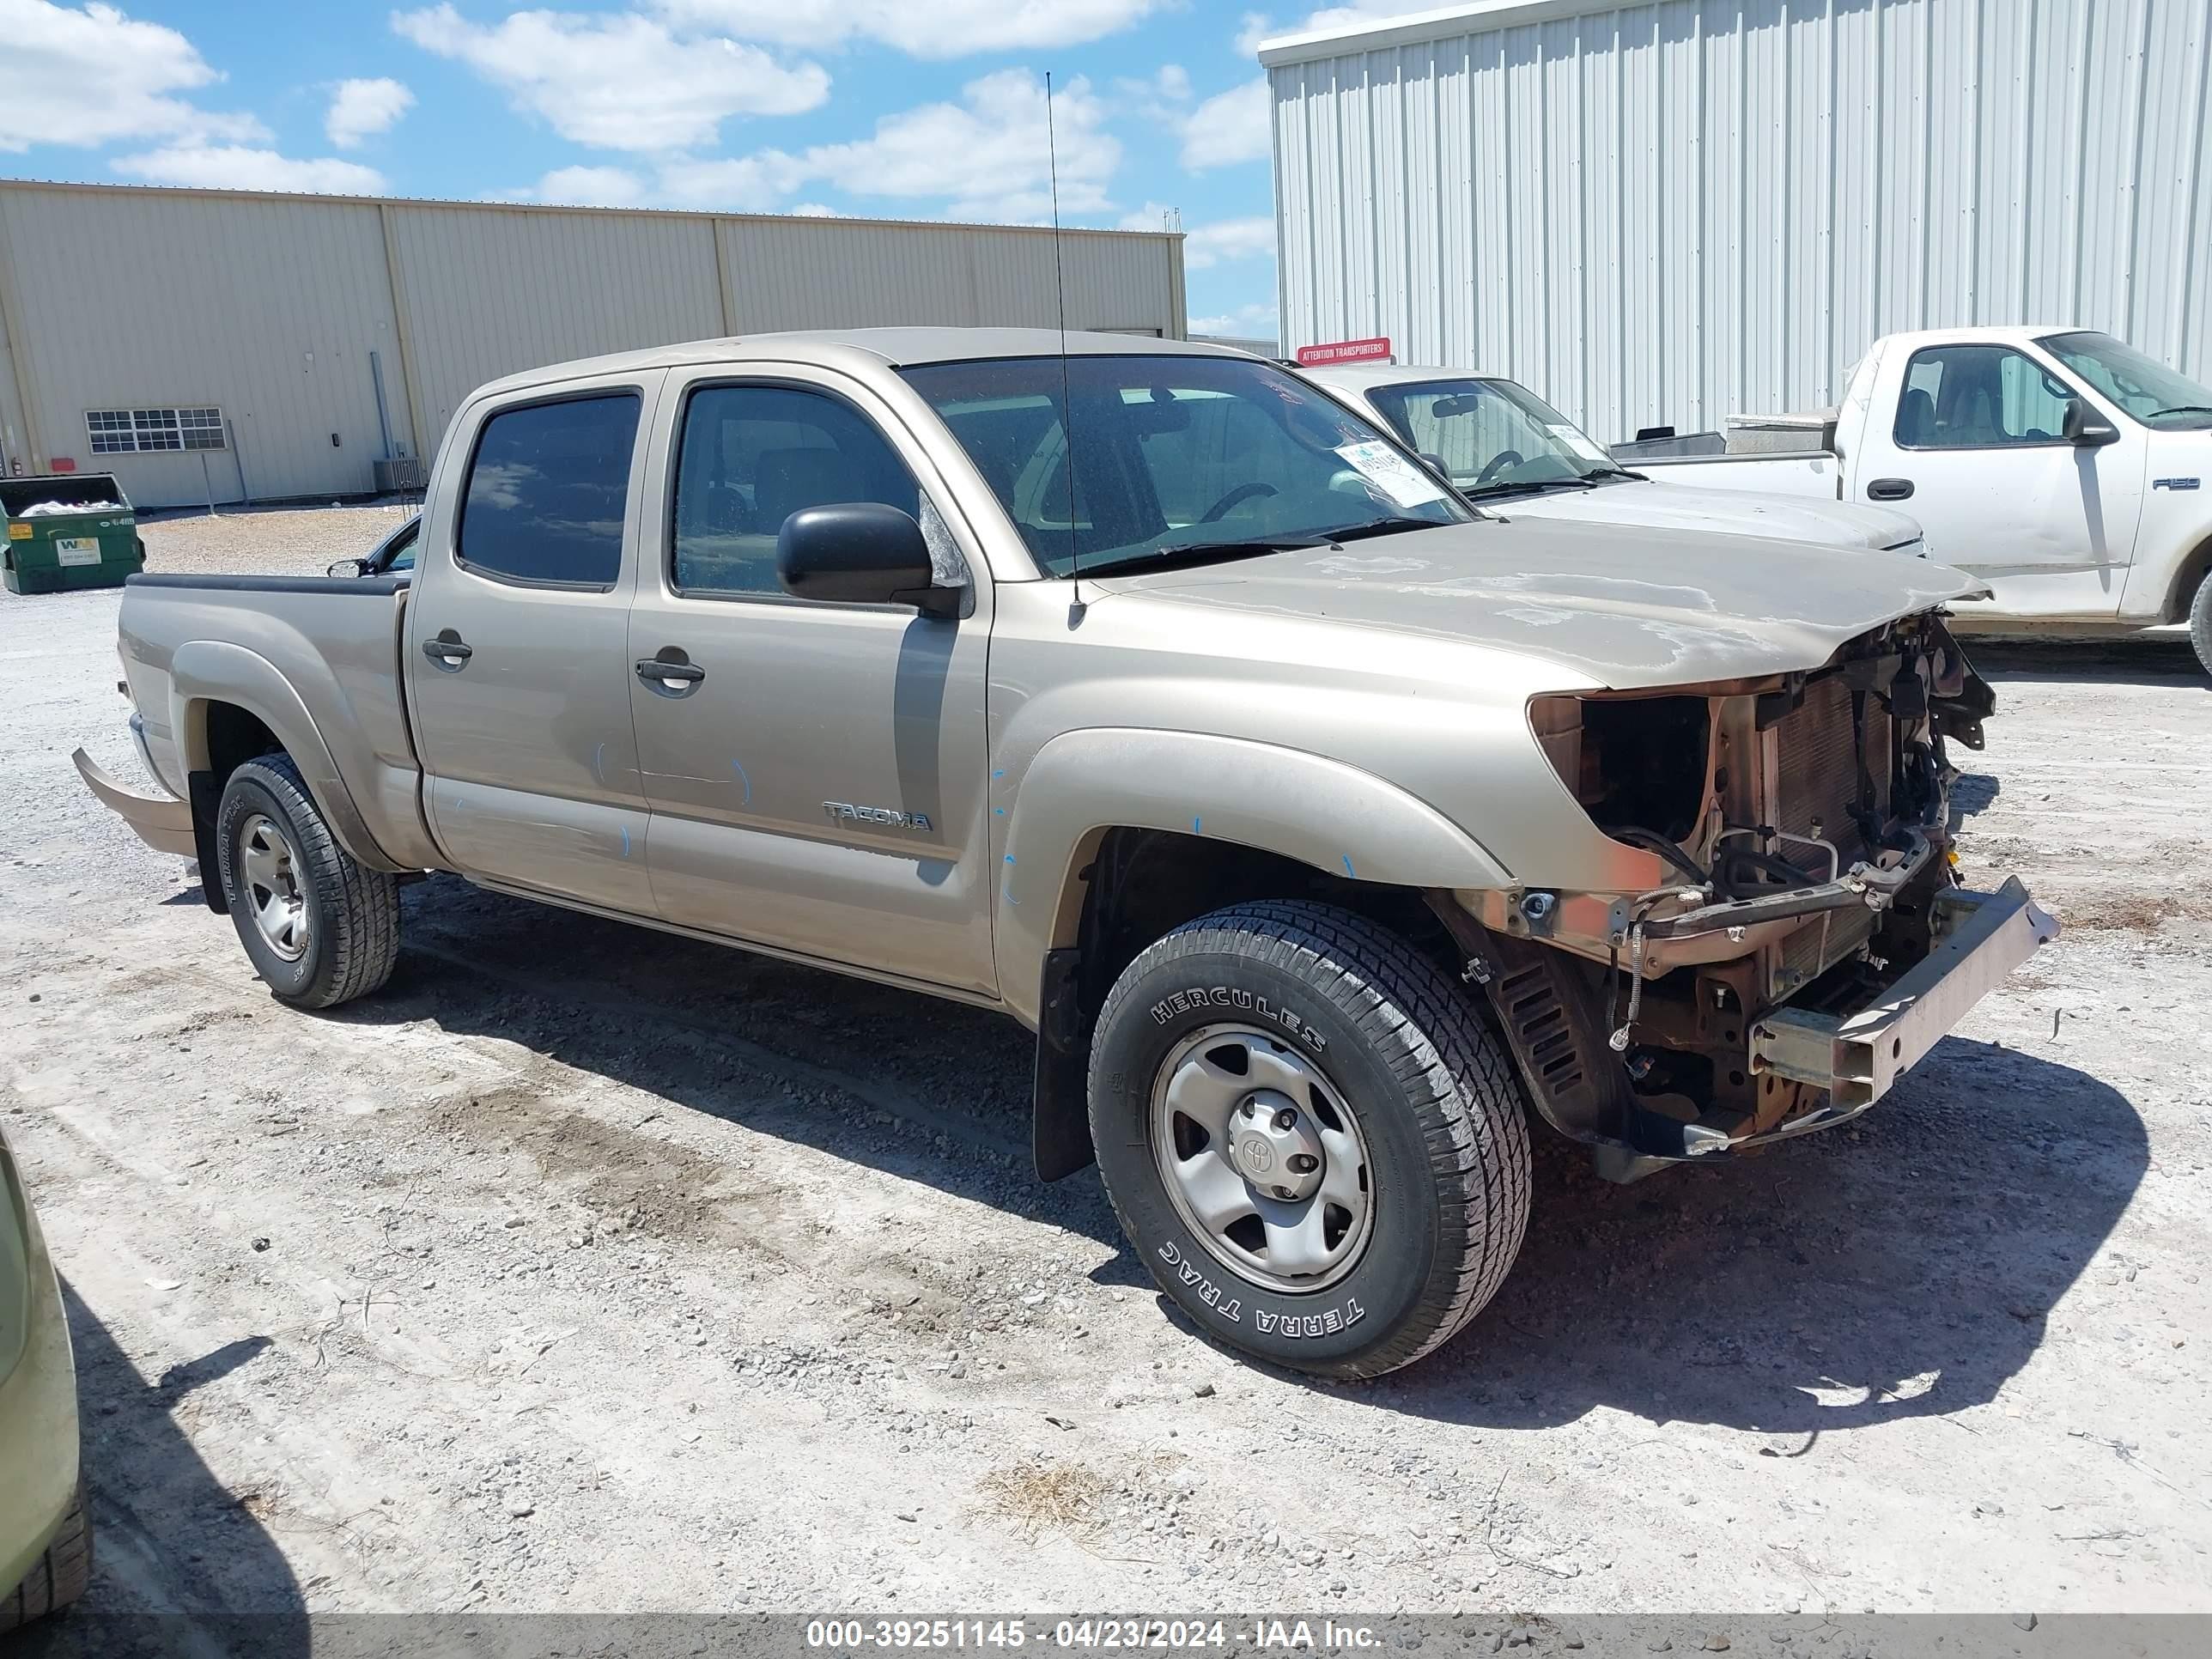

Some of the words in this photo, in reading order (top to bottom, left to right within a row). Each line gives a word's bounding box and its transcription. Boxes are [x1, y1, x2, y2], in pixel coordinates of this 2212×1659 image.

[1303, 348, 1334, 362] ATTENTION
[1335, 343, 1384, 357] TRANSPORTERS!
[822, 800, 934, 832] TACOMA
[1150, 986, 1328, 1054] HERCULES
[1158, 1240, 1243, 1324] TRAC
[1255, 1297, 1366, 1339] TERRA
